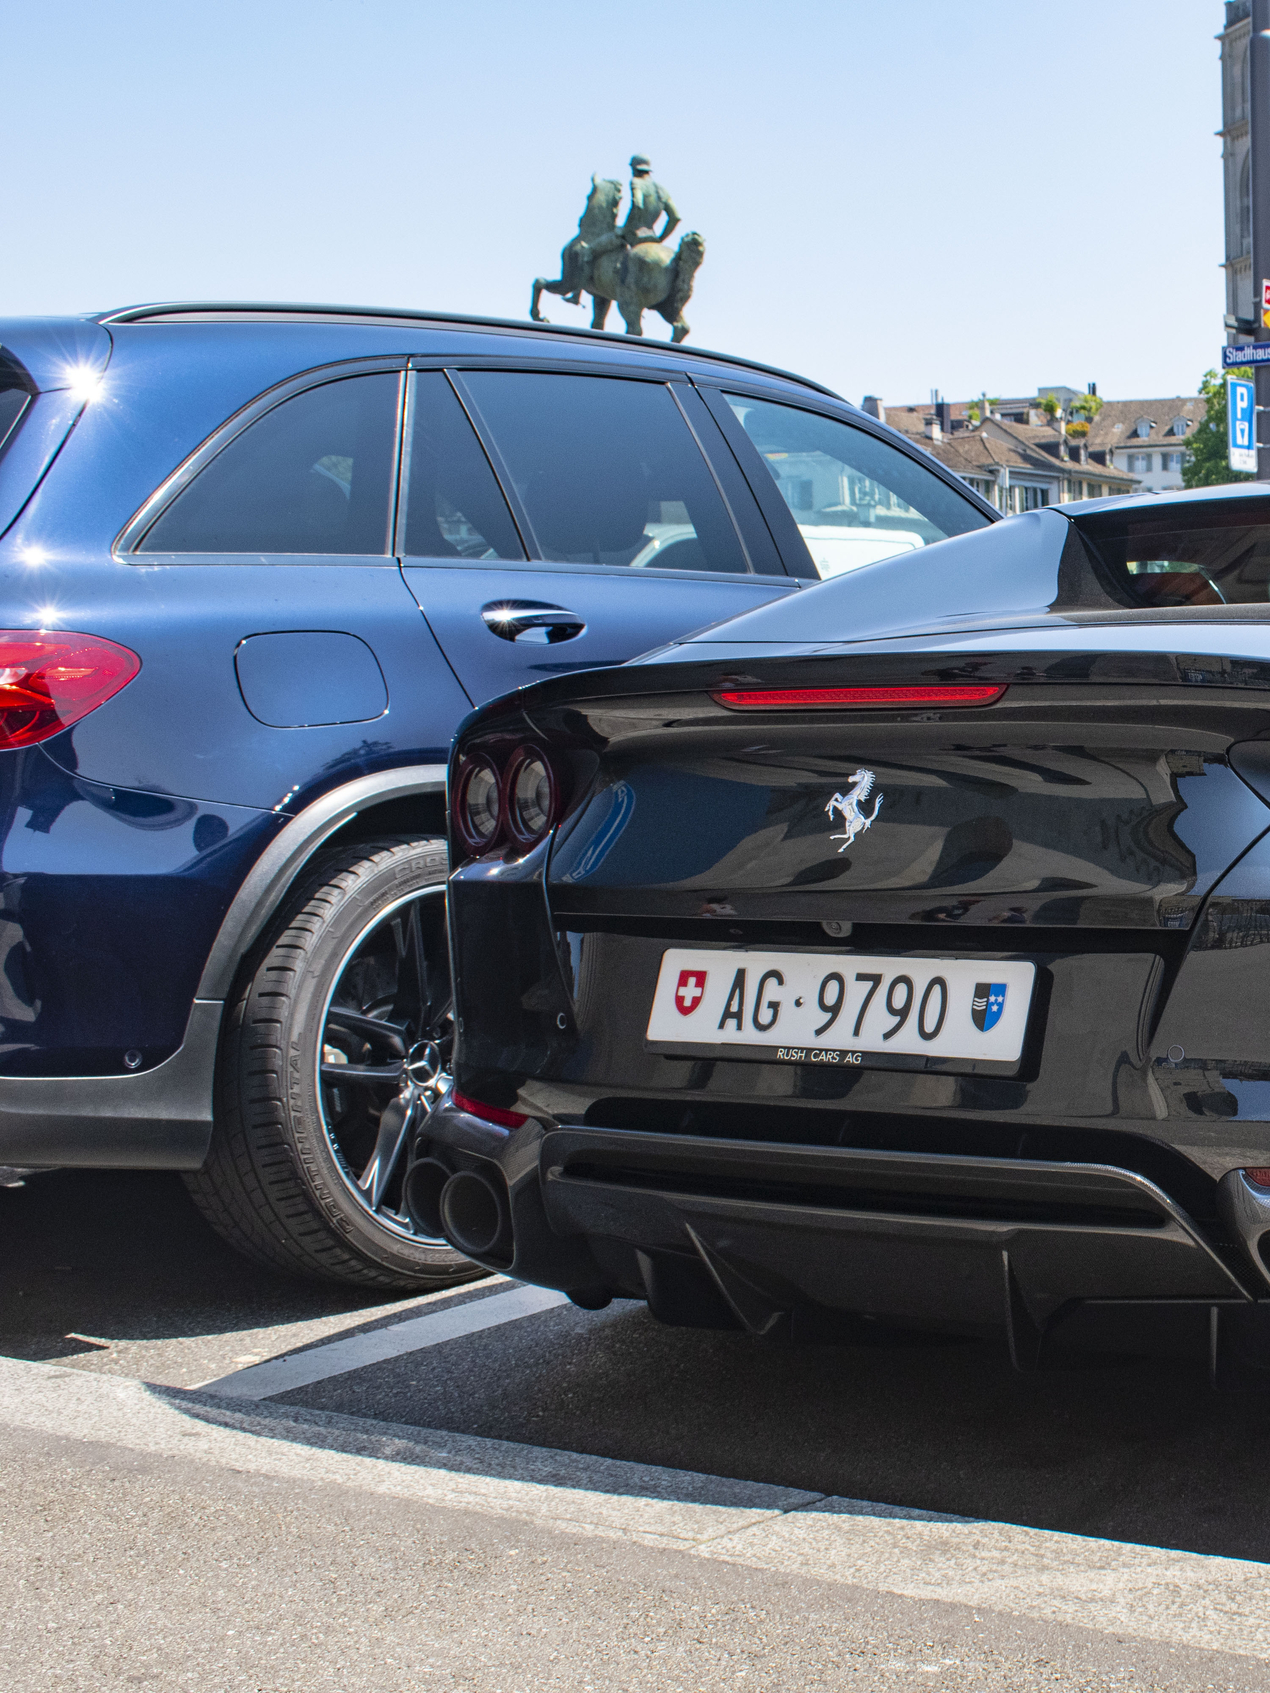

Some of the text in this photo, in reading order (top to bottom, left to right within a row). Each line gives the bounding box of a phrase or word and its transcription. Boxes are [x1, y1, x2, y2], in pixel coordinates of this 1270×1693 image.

[1236, 386, 1248, 419] P
[777, 1048, 862, 1064] RUSH CARS AG
